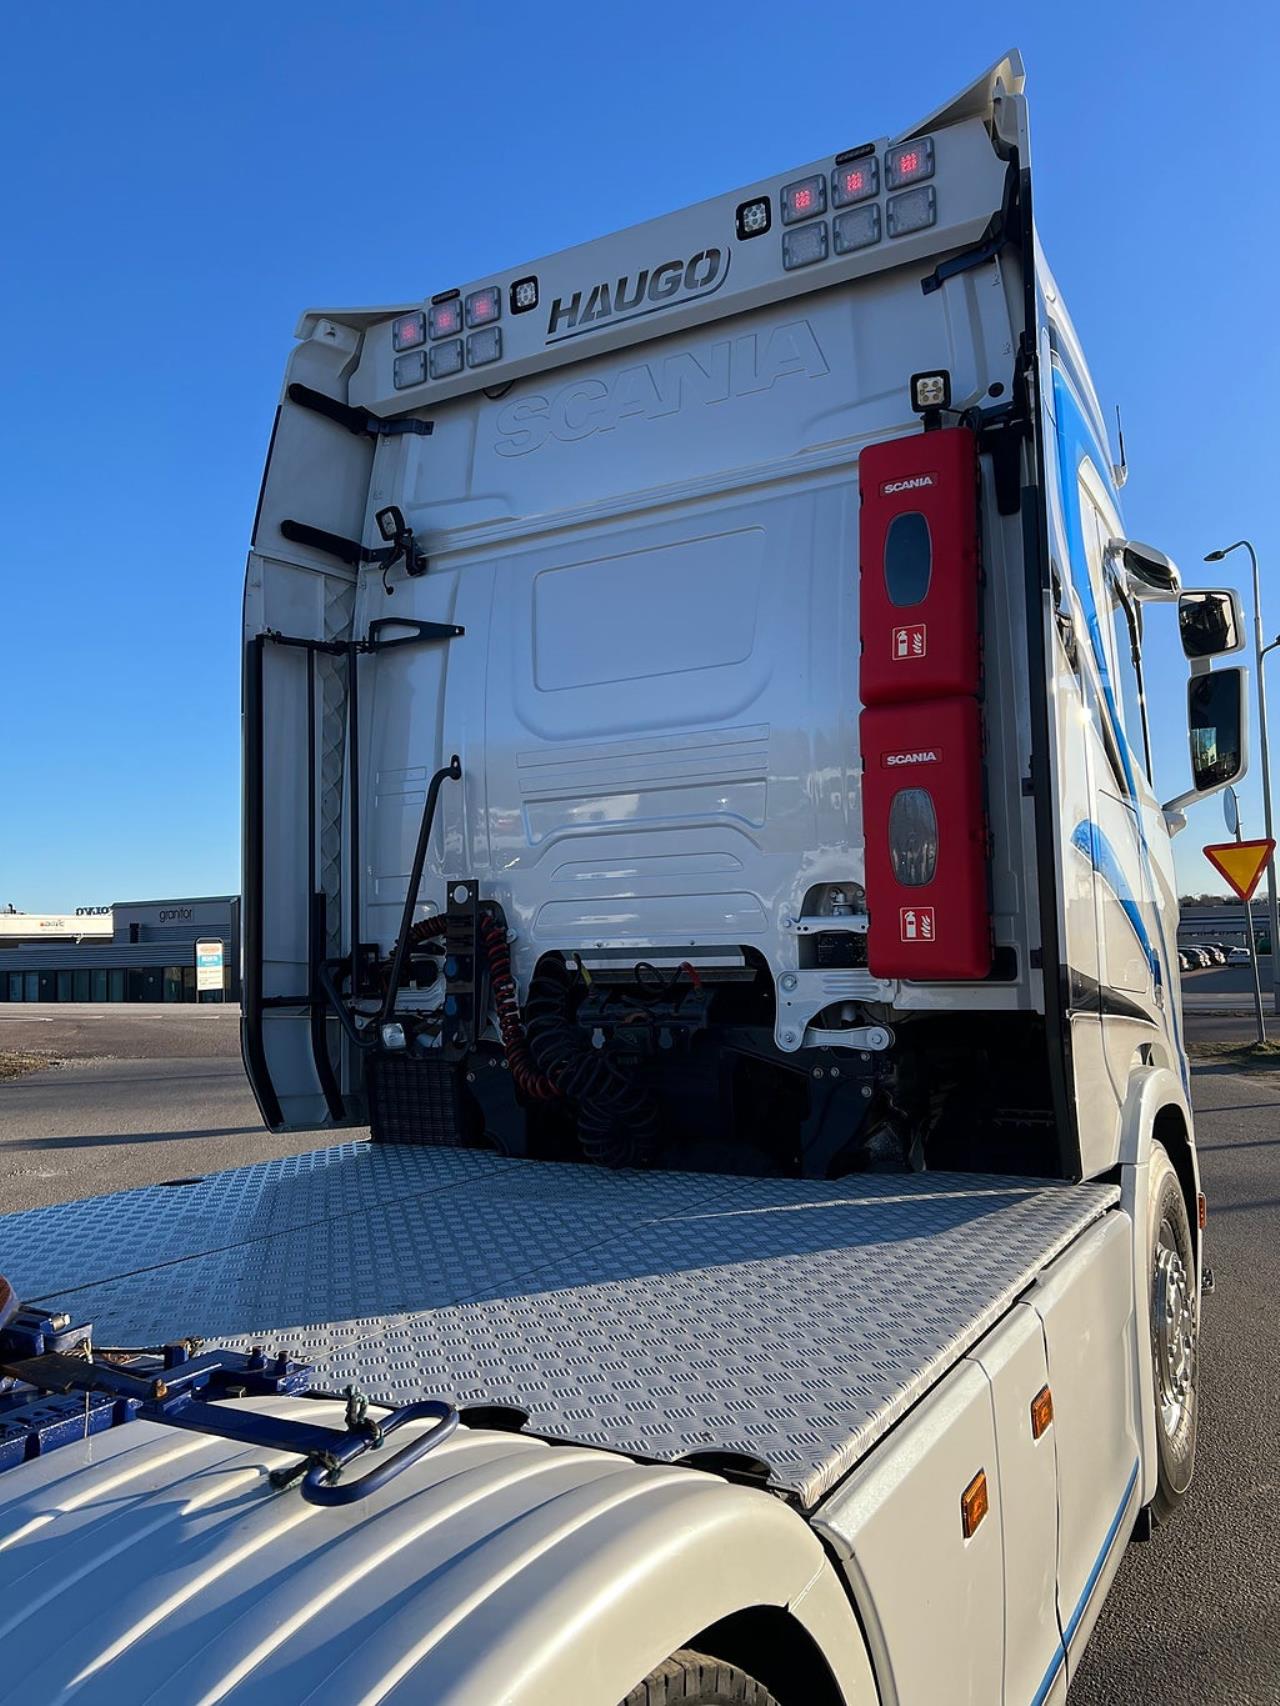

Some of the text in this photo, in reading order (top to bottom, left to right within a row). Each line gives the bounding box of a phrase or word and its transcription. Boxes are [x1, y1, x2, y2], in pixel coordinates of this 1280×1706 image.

[547, 248, 720, 334] HAUGO
[495, 320, 829, 457] SCANIA
[884, 476, 933, 494] SCANIA
[887, 751, 937, 765] SCANIA
